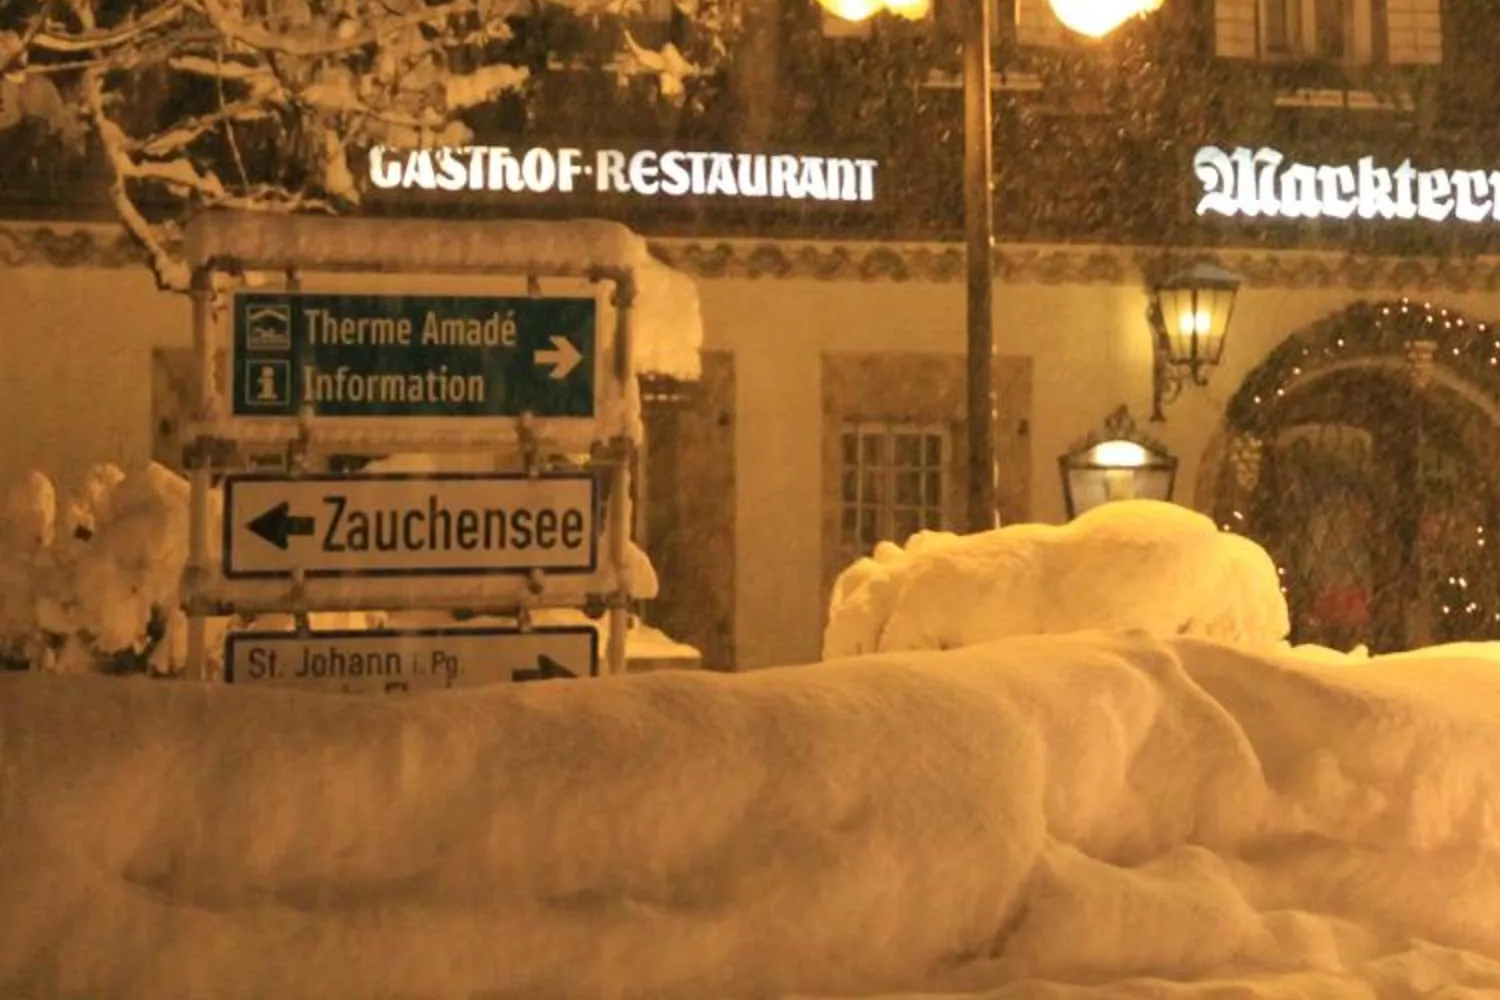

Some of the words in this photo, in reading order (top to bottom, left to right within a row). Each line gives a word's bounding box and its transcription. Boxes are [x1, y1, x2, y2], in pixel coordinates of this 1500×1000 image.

[304, 309, 412, 346] Therme
[421, 309, 517, 346] Amadé
[303, 364, 486, 402] Information
[322, 495, 583, 552] Zauchensee
[247, 646, 285, 679] St.
[294, 645, 401, 678] Johann
